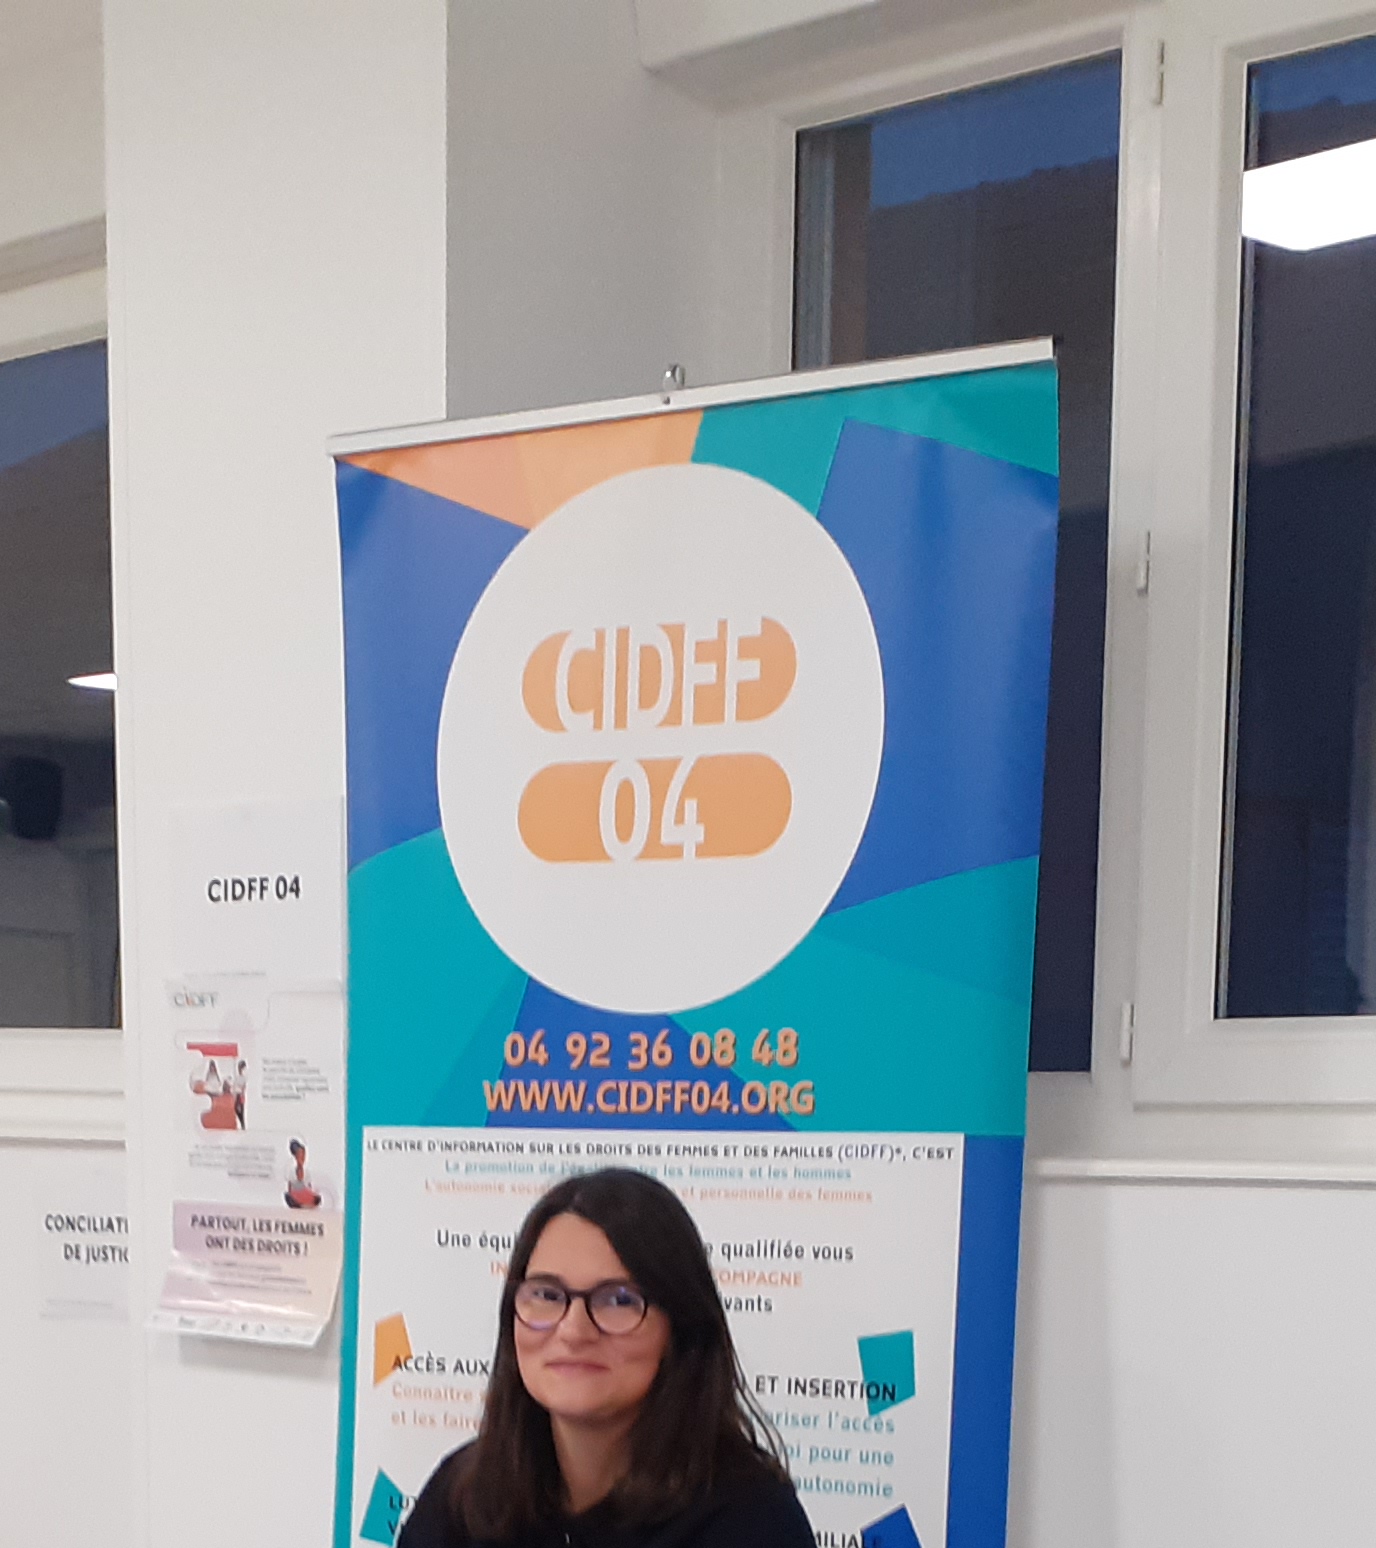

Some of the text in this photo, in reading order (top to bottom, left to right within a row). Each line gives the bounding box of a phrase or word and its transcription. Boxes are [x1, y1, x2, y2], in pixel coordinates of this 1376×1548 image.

[554, 615, 763, 732] CIDFF
[599, 756, 705, 862] 04
[207, 874, 301, 903] CIDFF 04
[503, 1027, 800, 1071] 04 92 36 08 48
[482, 1079, 816, 1115] WWW.CIDFF04.ORG
[381, 1139, 422, 1152] CENTRE
[427, 1140, 524, 1154] D'INFORMATION
[529, 1142, 554, 1155] SUR
[559, 1142, 581, 1154] LES
[586, 1143, 632, 1156] DROITS
[637, 1143, 662, 1156] DES
[666, 1144, 719, 1157] FEMMES
[723, 1145, 739, 1157] ET
[743, 1145, 769, 1157] DES
[773, 1145, 834, 1158] FAMILLES
[912, 1146, 955, 1160] C'EST
[252, 1216, 272, 1233] LES
[274, 1218, 325, 1237] FEMMES
[64, 1243, 81, 1261] DE
[205, 1234, 230, 1250] ONT
[232, 1236, 254, 1252] DES
[256, 1239, 301, 1257] DROITS
[436, 1229, 472, 1247] Une
[721, 1238, 805, 1262] qualifiée
[811, 1244, 854, 1261] vous
[392, 1350, 490, 1376] ACCÈS AUX
[755, 1374, 897, 1402] ET INSERTION
[808, 1444, 851, 1464] pour
[859, 1450, 895, 1467] une
